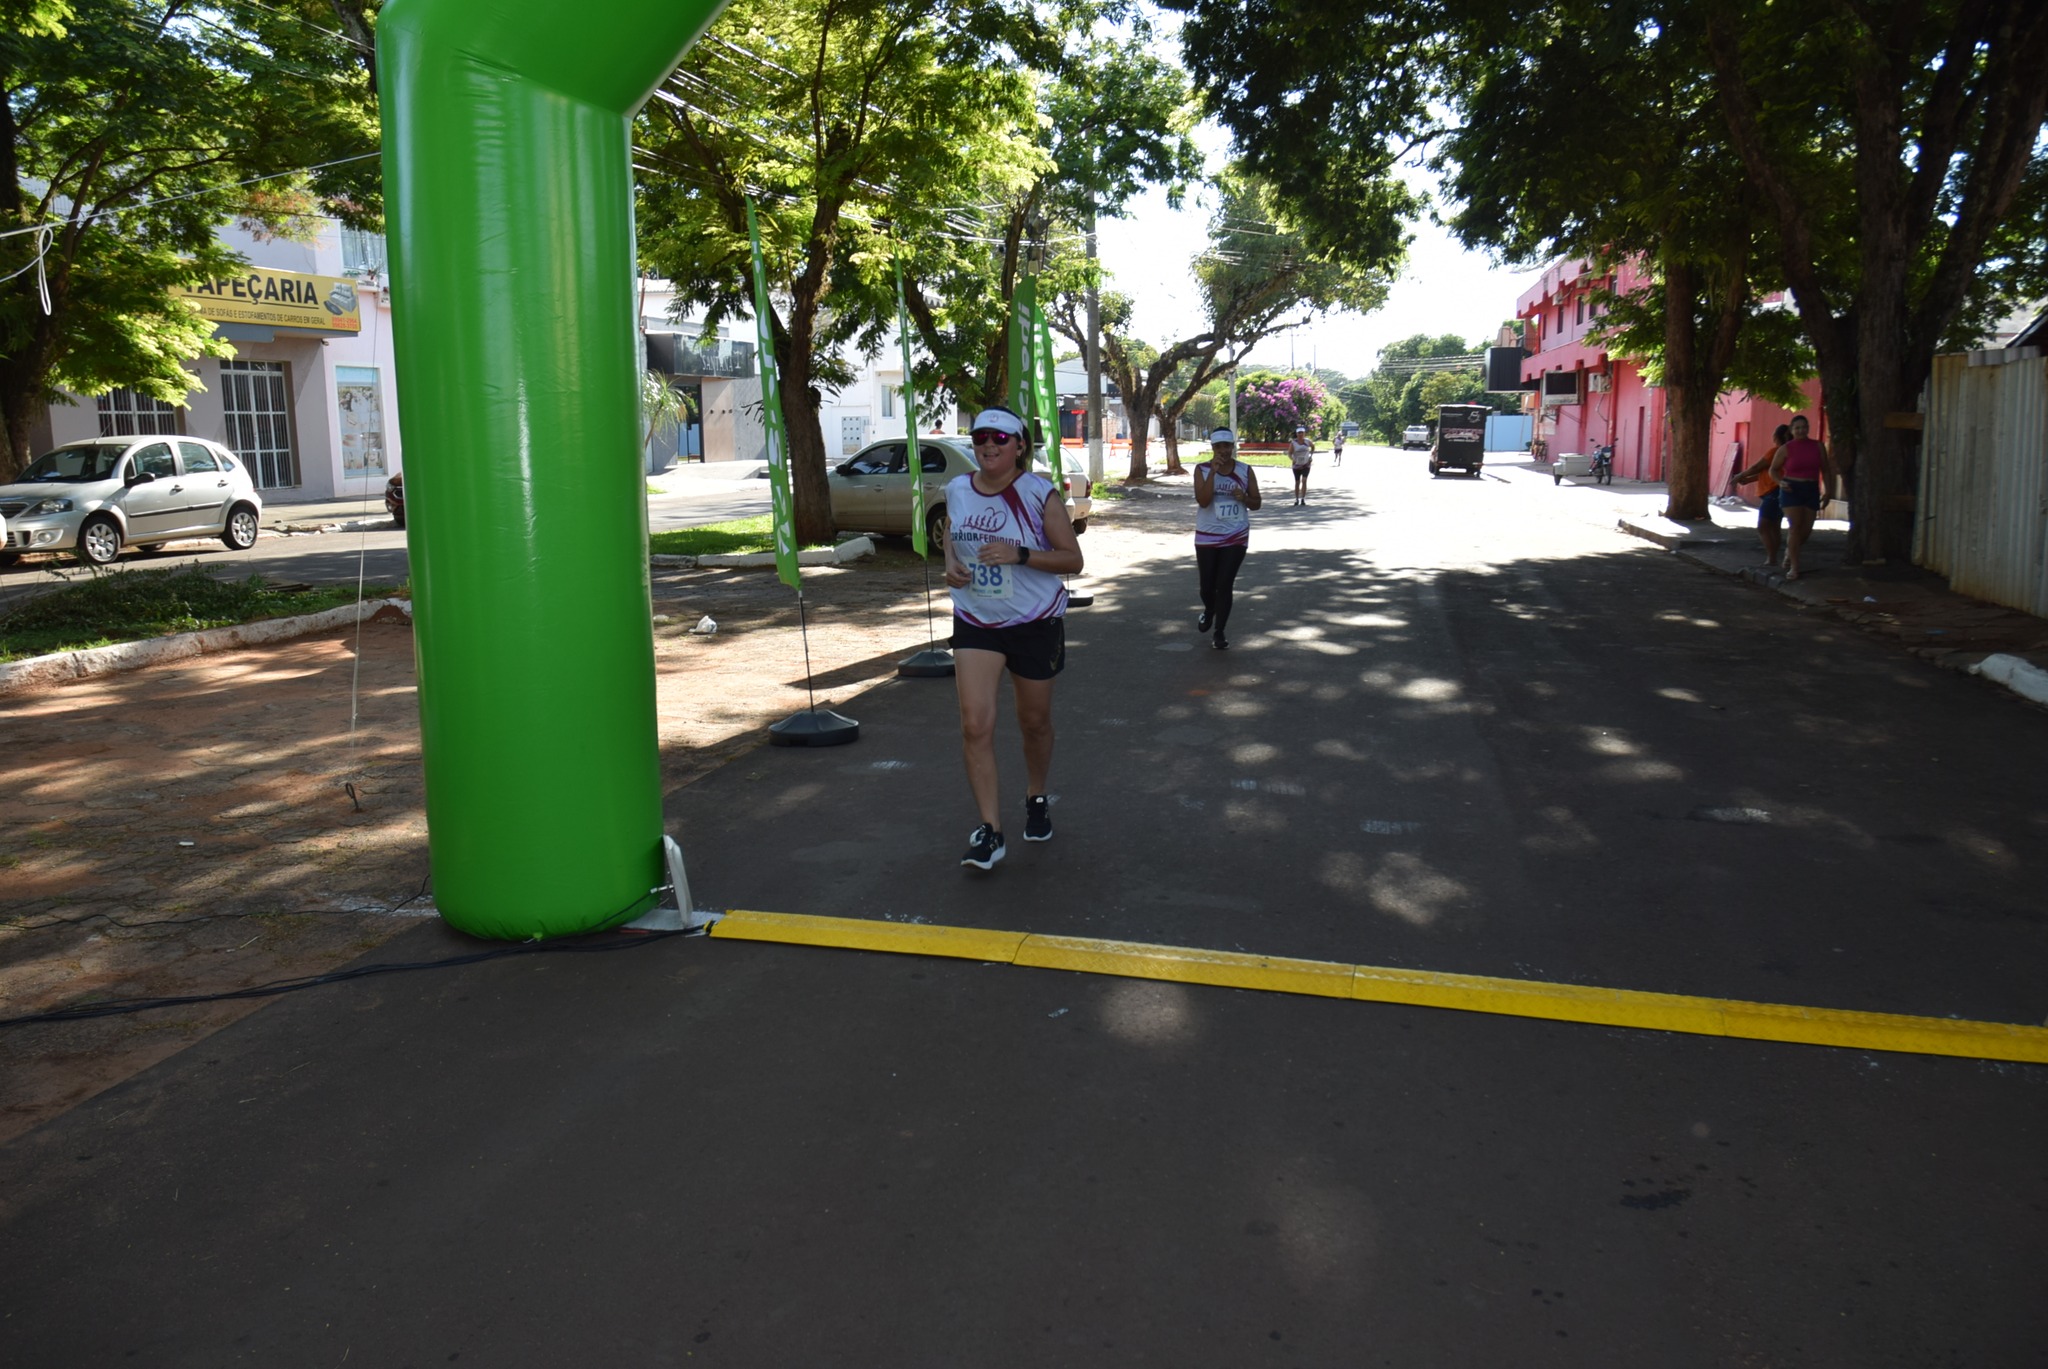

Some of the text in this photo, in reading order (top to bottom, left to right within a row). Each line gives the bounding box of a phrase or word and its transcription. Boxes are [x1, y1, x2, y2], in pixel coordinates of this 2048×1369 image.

[208, 308, 216, 316] DE
[277, 314, 283, 322] DE
[1219, 503, 1239, 517] 770
[968, 562, 1003, 587] 738
